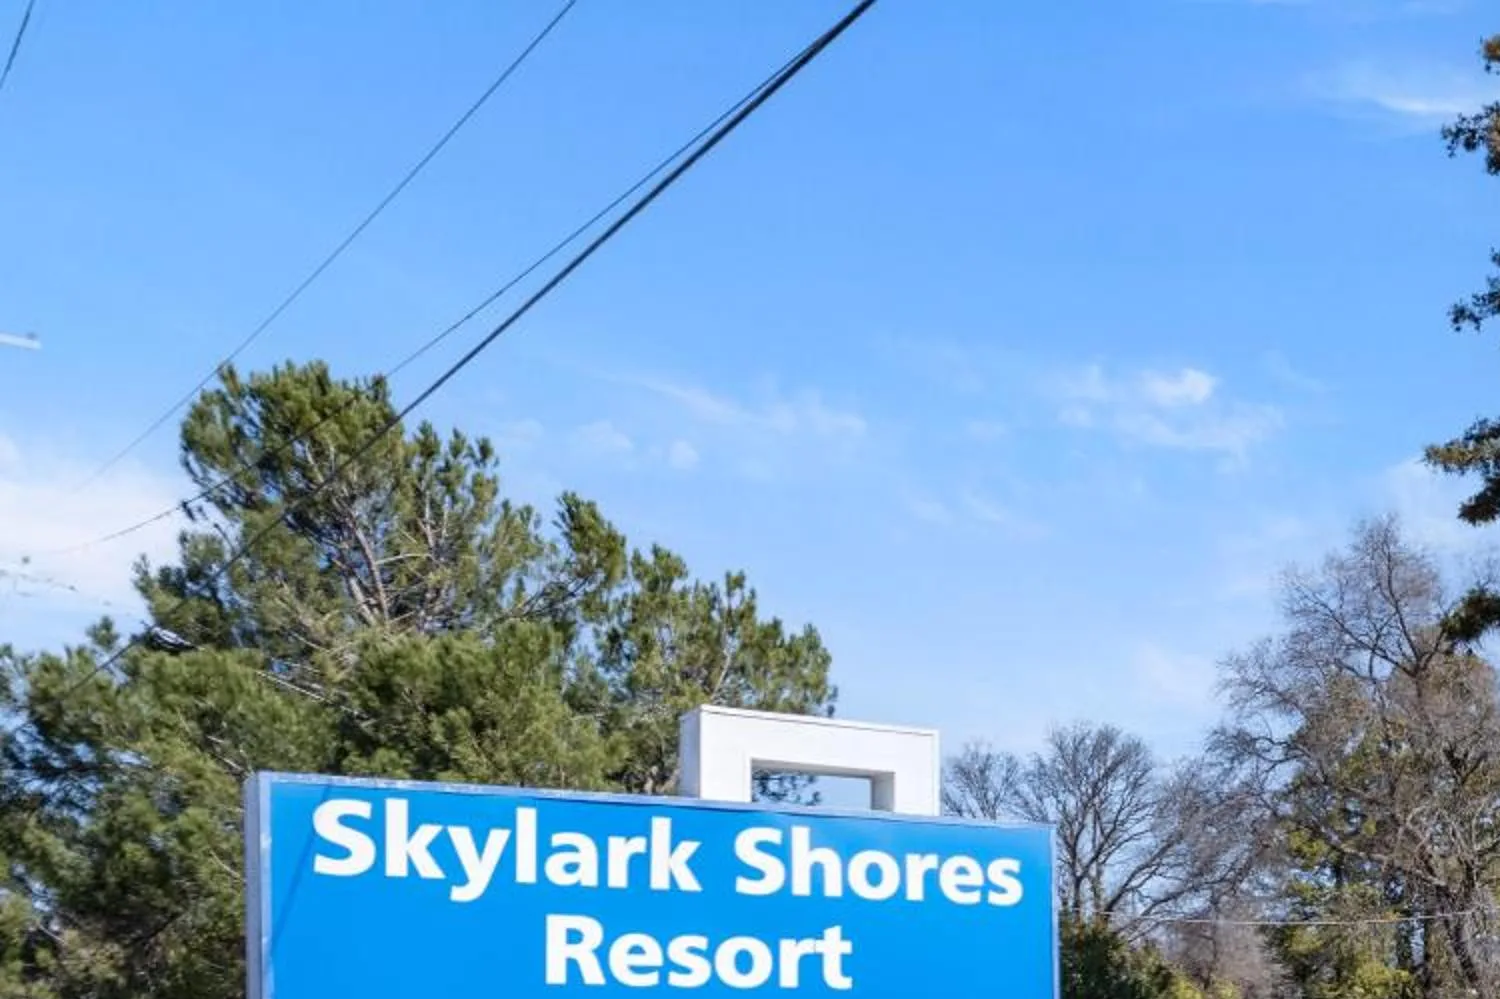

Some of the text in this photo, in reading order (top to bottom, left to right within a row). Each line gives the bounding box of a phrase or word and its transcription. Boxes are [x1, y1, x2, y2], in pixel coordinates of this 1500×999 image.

[312, 798, 1024, 906] Skylark Shores
[545, 914, 853, 990] Resort
